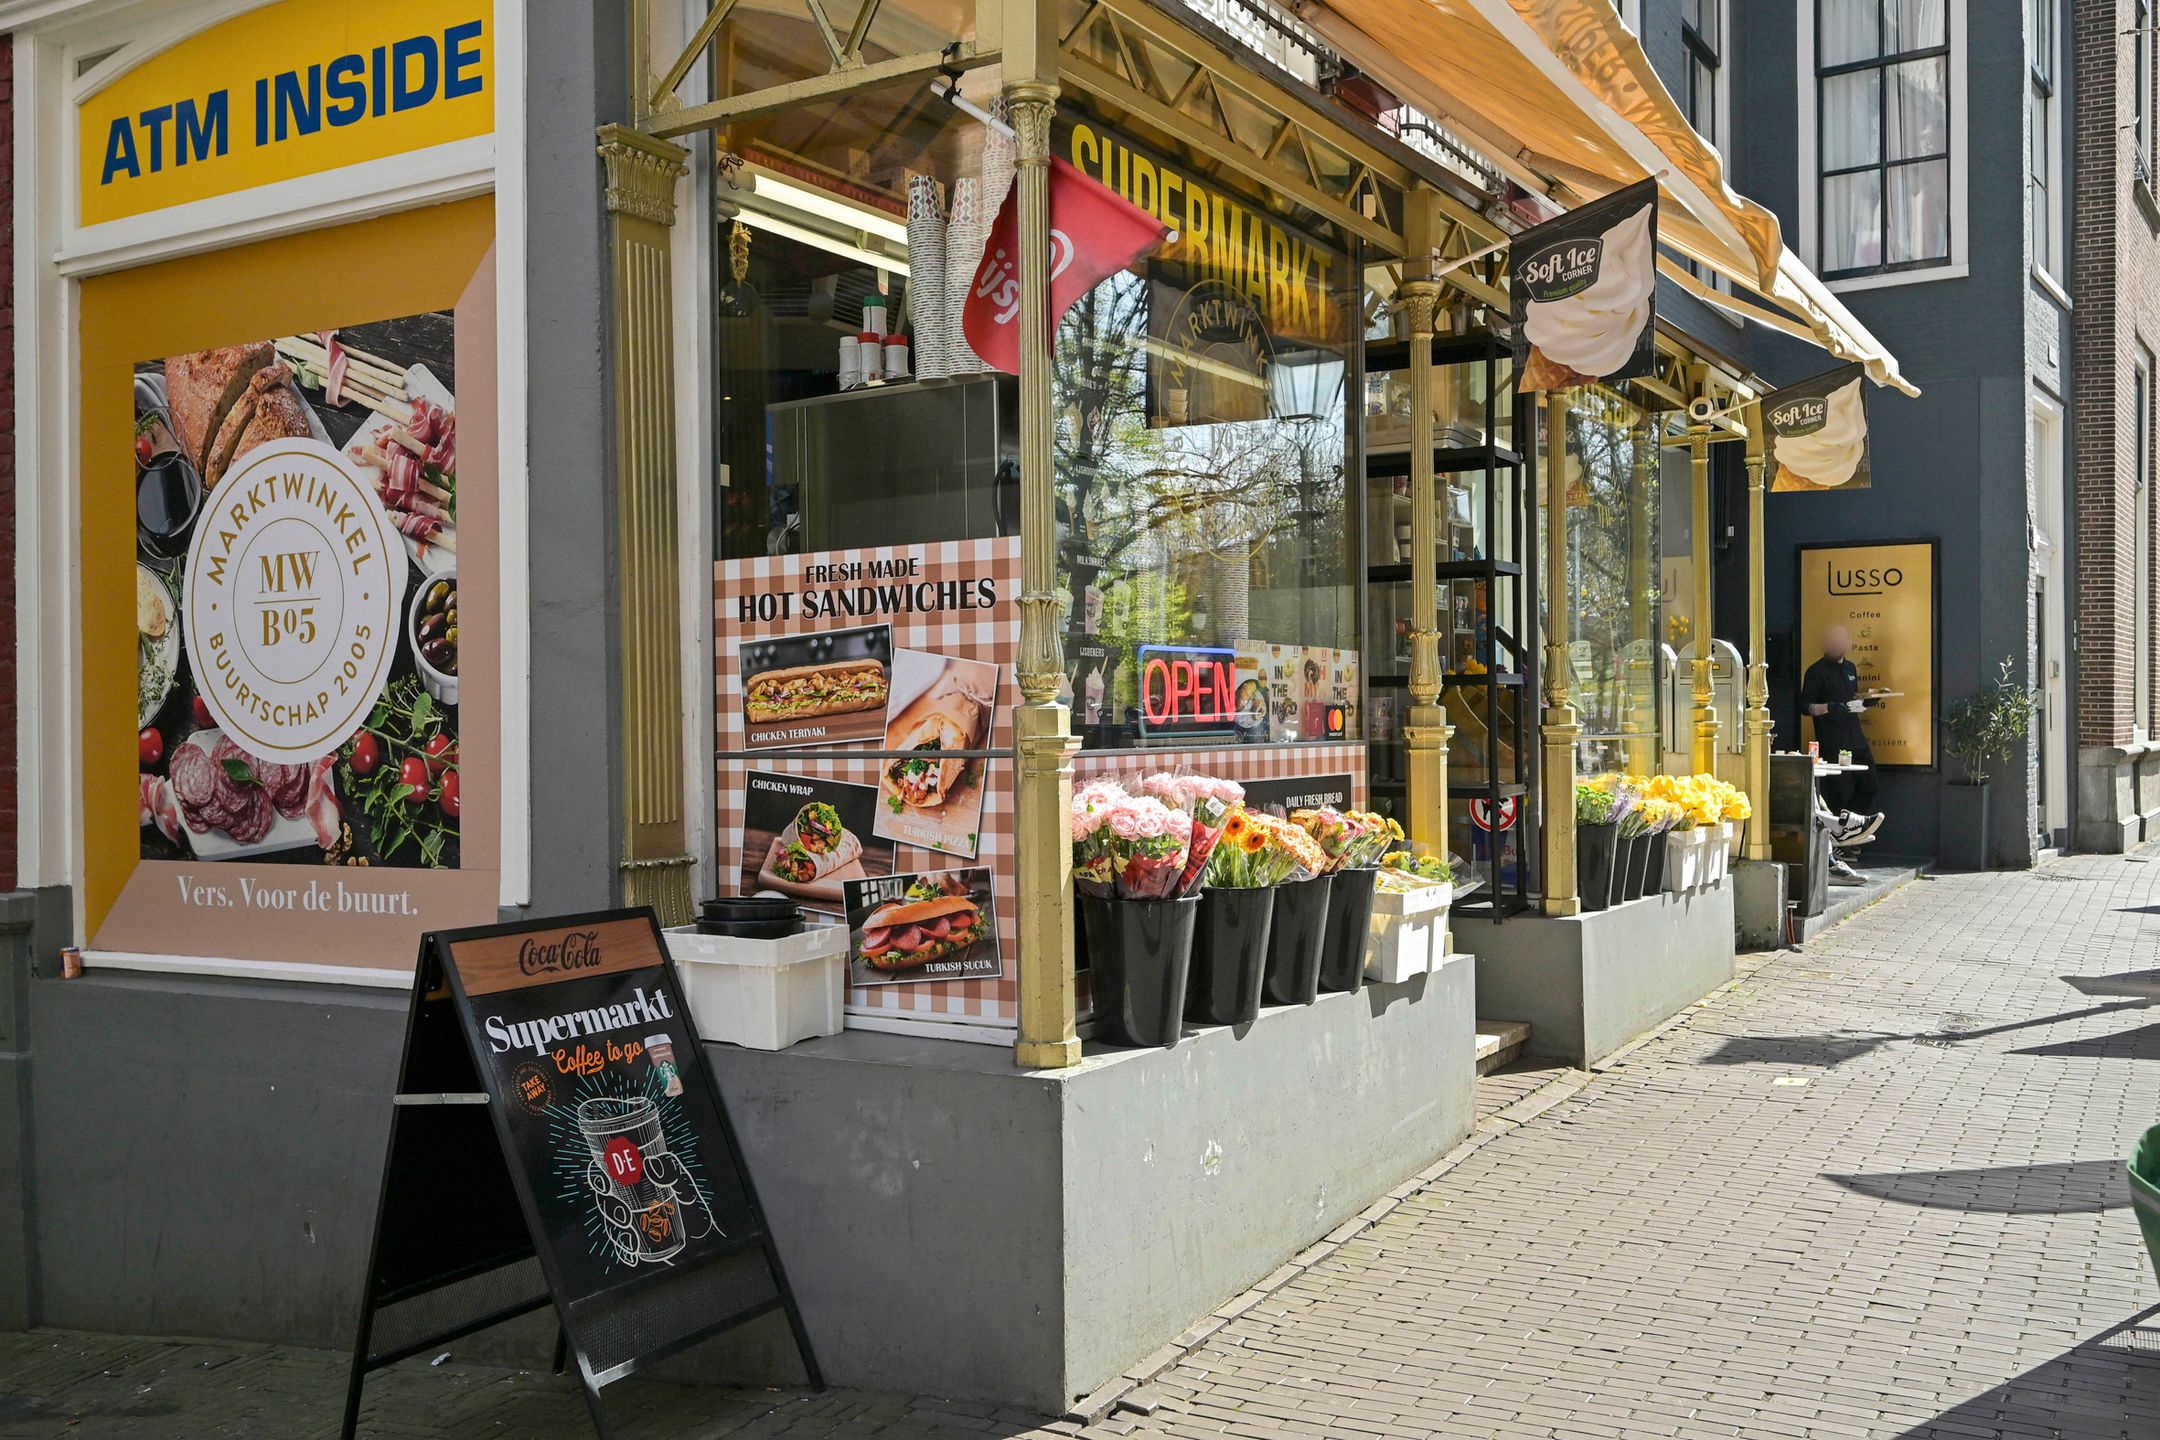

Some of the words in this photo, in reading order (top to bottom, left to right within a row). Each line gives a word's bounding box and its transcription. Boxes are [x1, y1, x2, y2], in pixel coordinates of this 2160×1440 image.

[100, 88, 230, 185] ATM
[255, 20, 483, 146] INSIDE
[1526, 253, 1565, 284] Soft
[1567, 247, 1596, 269] Ice
[1562, 265, 1593, 282] CORNER
[1543, 287, 1569, 298] Premium
[1569, 279, 1587, 294] quality
[1773, 406, 1802, 426] Soft
[1802, 403, 1823, 418] Ice
[1800, 415, 1823, 426] CORNER
[206, 471, 375, 588] MARKTWINKEL
[258, 550, 321, 595] MW
[806, 562, 861, 584] FRESH
[868, 557, 920, 580] MADE
[738, 592, 794, 623] HOT
[802, 577, 997, 620] SANDWICHES
[1849, 611, 1881, 619] Coffee
[209, 635, 330, 727] BUURTSCHAP
[333, 622, 373, 698] 2005
[1274, 665, 1283, 680] IN
[1334, 670, 1343, 683] IN
[1142, 658, 1236, 725] OPEN
[1271, 683, 1288, 698] THE
[1332, 687, 1347, 700] THE
[751, 730, 787, 743] CHICKEN
[788, 726, 826, 740] TERIYAKI
[751, 778, 788, 795] CHICKEN
[789, 782, 814, 797] WRAP
[1286, 796, 1304, 808] DAILY
[1304, 793, 1322, 806] FRESH
[1323, 792, 1343, 804] BREAD
[903, 824, 942, 844] TURKISH
[943, 831, 972, 850] PIZZA
[177, 875, 234, 911] Vers.
[237, 877, 297, 912] Voor
[302, 878, 333, 911] de
[336, 883, 419, 916] buurt.
[925, 961, 962, 974] TURKISH
[963, 959, 993, 972] SUCUK
[485, 988, 674, 1057] Supermarkt
[551, 1044, 605, 1076] Coffee
[606, 1039, 624, 1062] to
[623, 1041, 645, 1065] go
[521, 1074, 541, 1092] TAKE
[526, 1083, 547, 1102] AWAY
